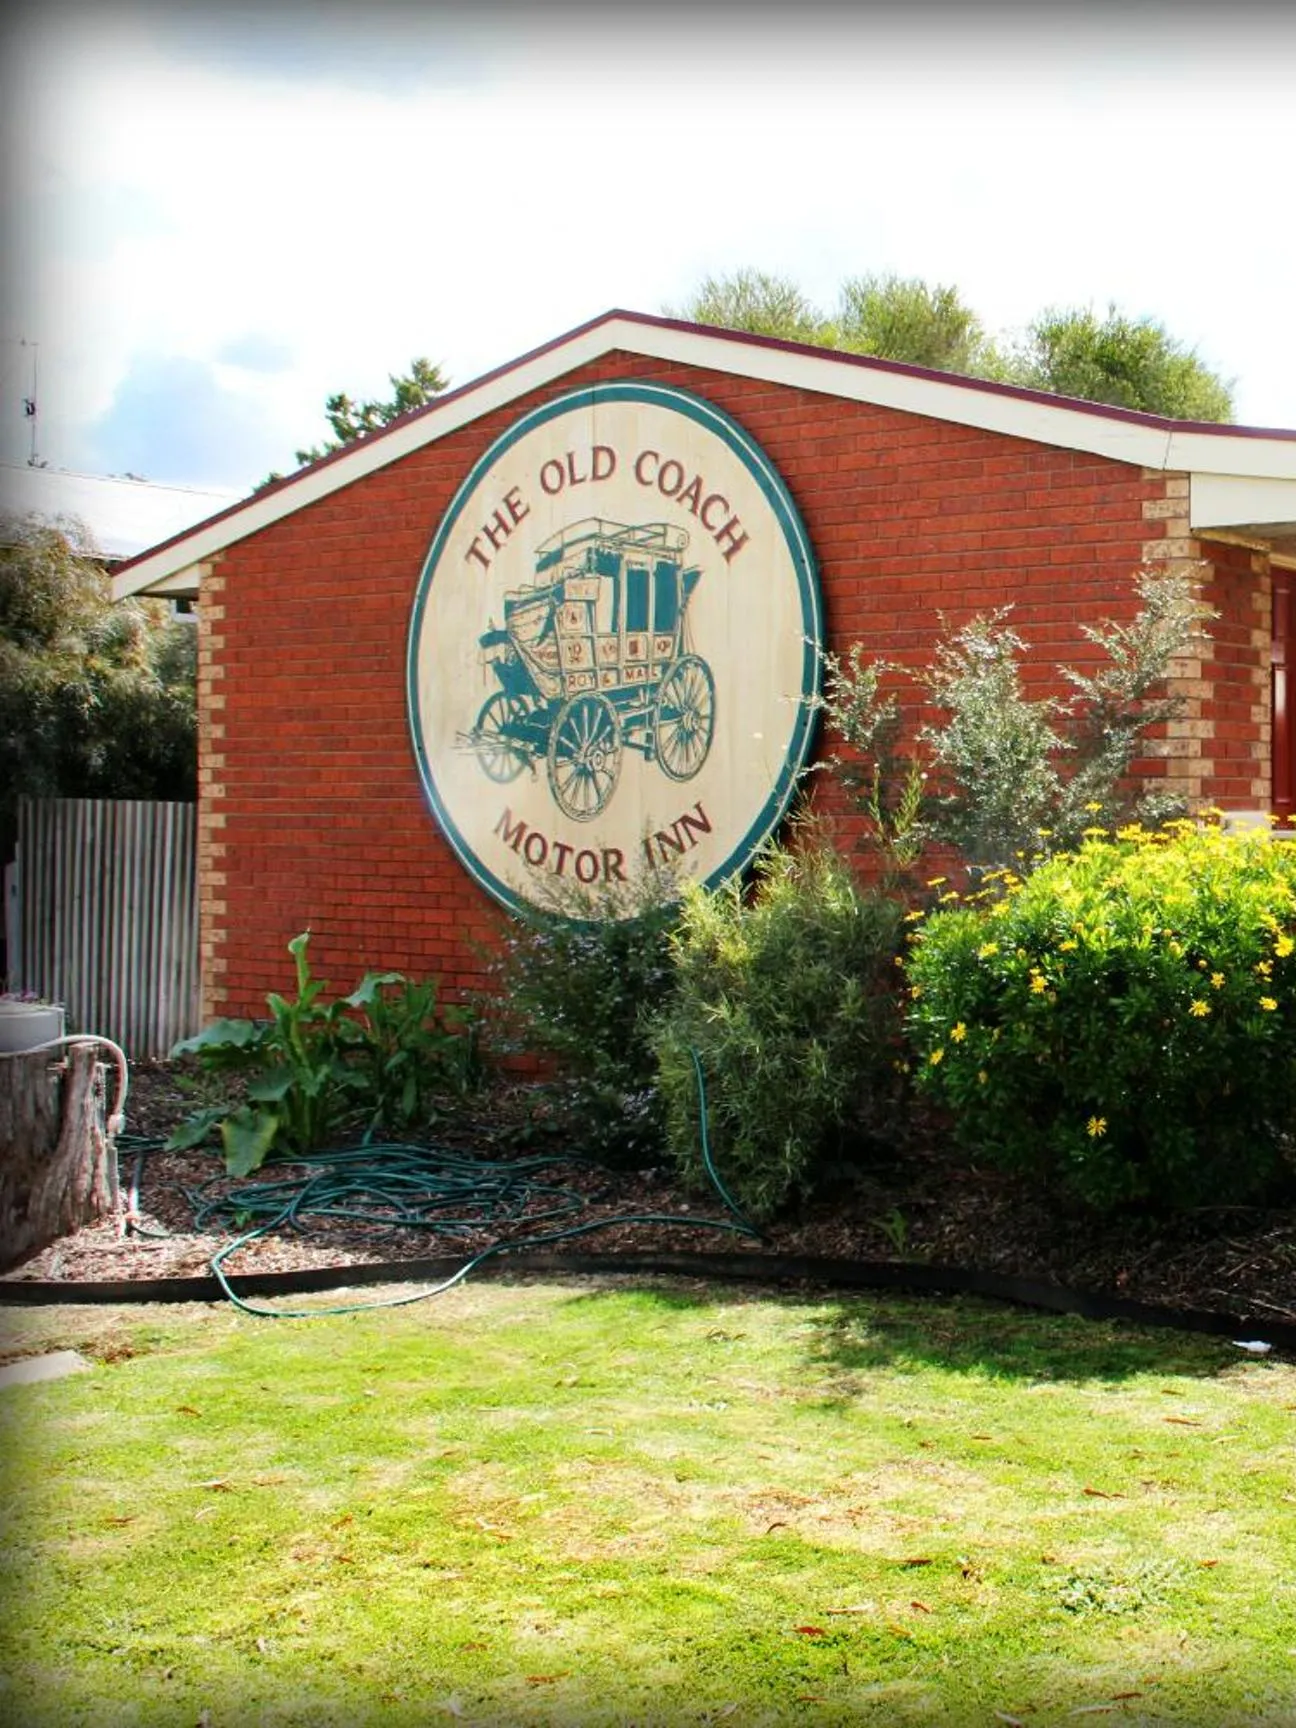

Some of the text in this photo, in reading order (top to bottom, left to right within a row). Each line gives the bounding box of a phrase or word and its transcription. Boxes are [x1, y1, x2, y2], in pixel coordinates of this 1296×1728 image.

[464, 445, 750, 571] THE OLD COACH
[493, 801, 712, 884] MOTOR INN
